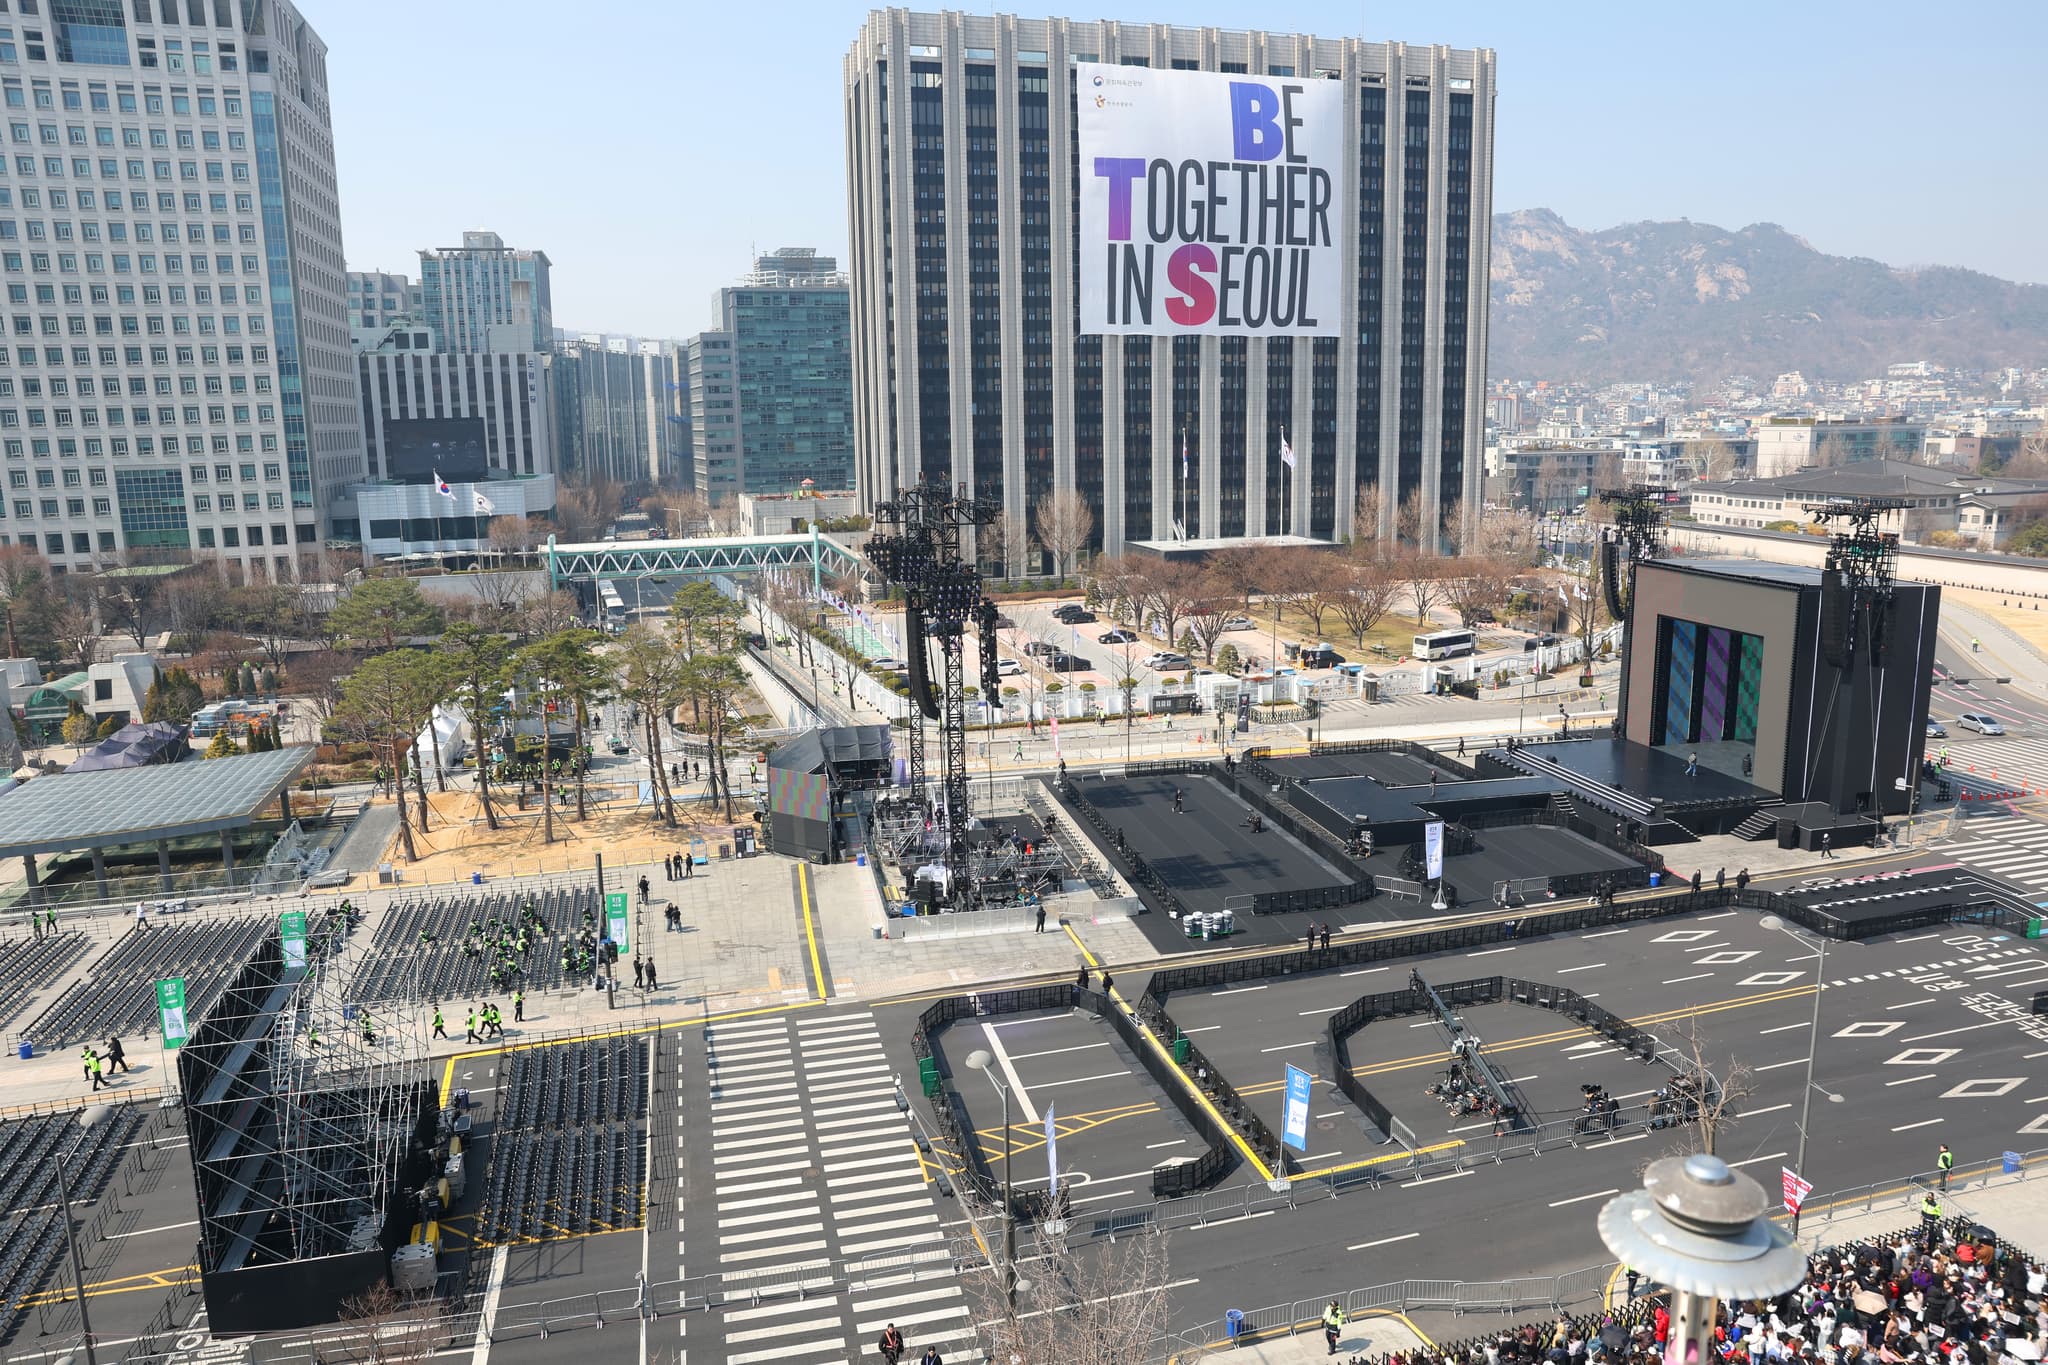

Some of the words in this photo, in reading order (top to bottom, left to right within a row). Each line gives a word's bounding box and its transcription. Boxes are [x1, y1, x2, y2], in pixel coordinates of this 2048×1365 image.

[1229, 81, 1308, 164] BE
[1094, 157, 1332, 247] TOGETHER
[1107, 243, 1154, 325] IN
[1164, 243, 1318, 329] SEOUL
[1942, 935, 2000, 953] 50
